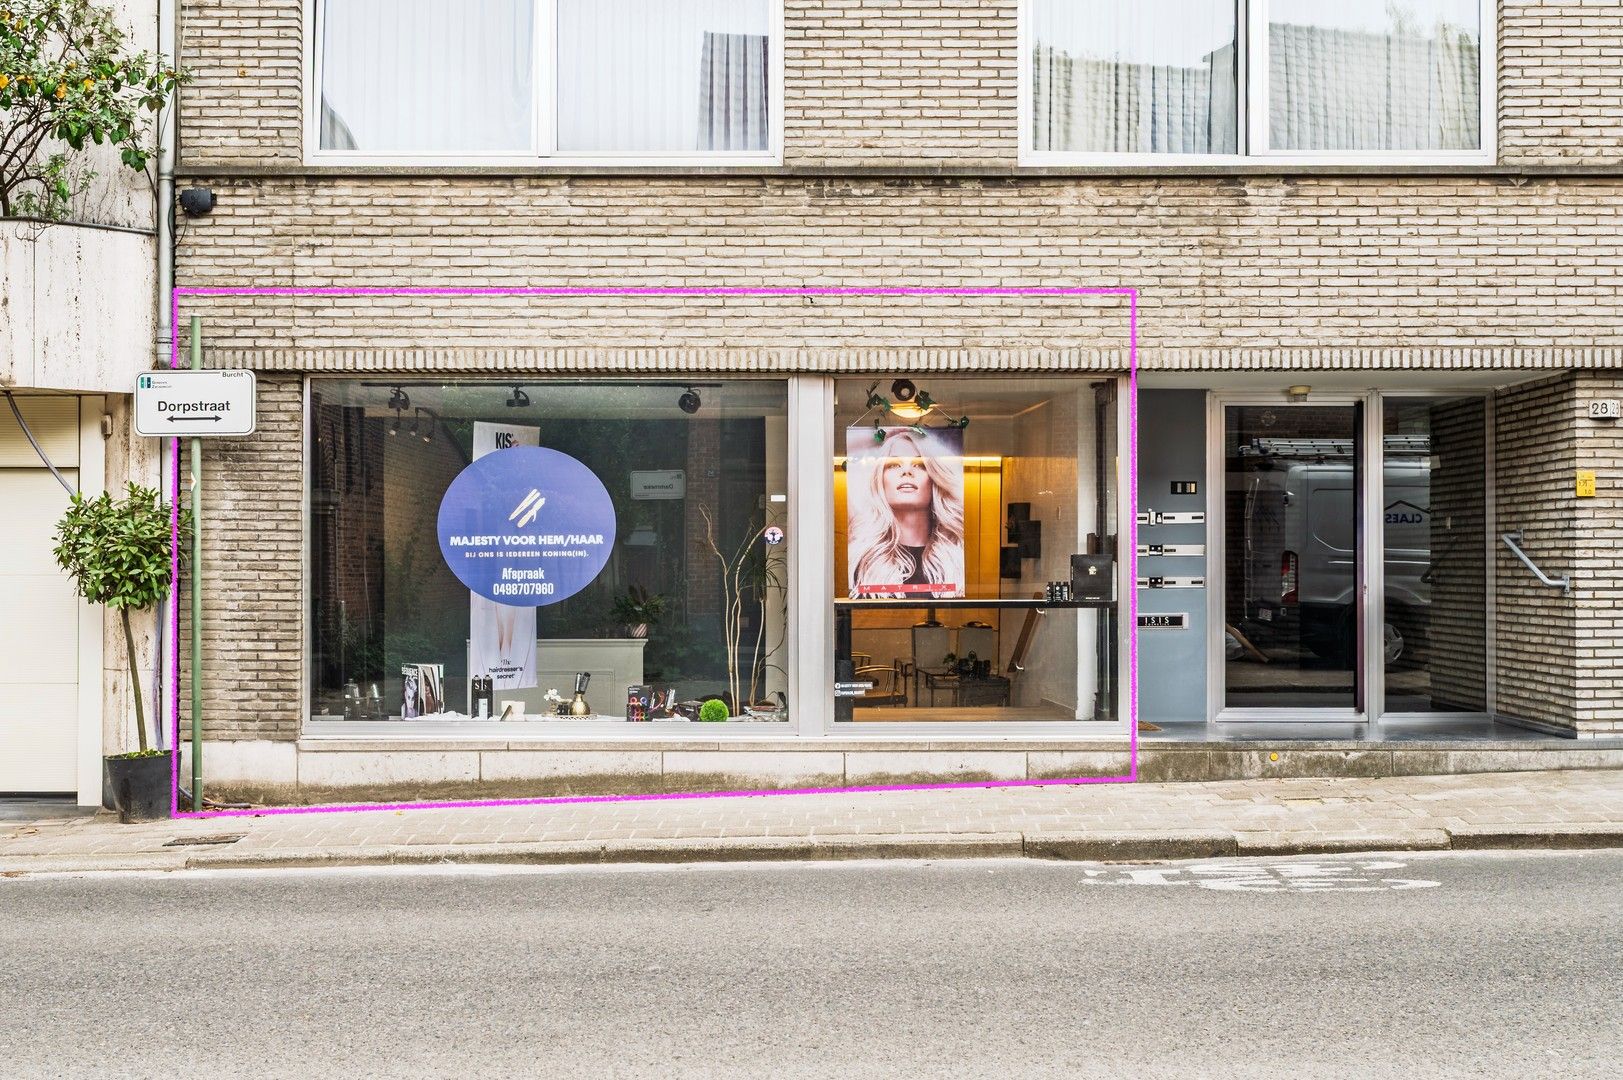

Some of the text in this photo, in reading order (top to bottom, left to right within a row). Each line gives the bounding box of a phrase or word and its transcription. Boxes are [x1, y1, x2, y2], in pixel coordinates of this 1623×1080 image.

[157, 400, 231, 414] Dorpstraat
[1592, 402, 1608, 415] 28
[450, 535, 604, 547] MAJESTY VOOR HEM/HAAR
[502, 568, 545, 582] Afspraak
[493, 583, 554, 596] 0498707960
